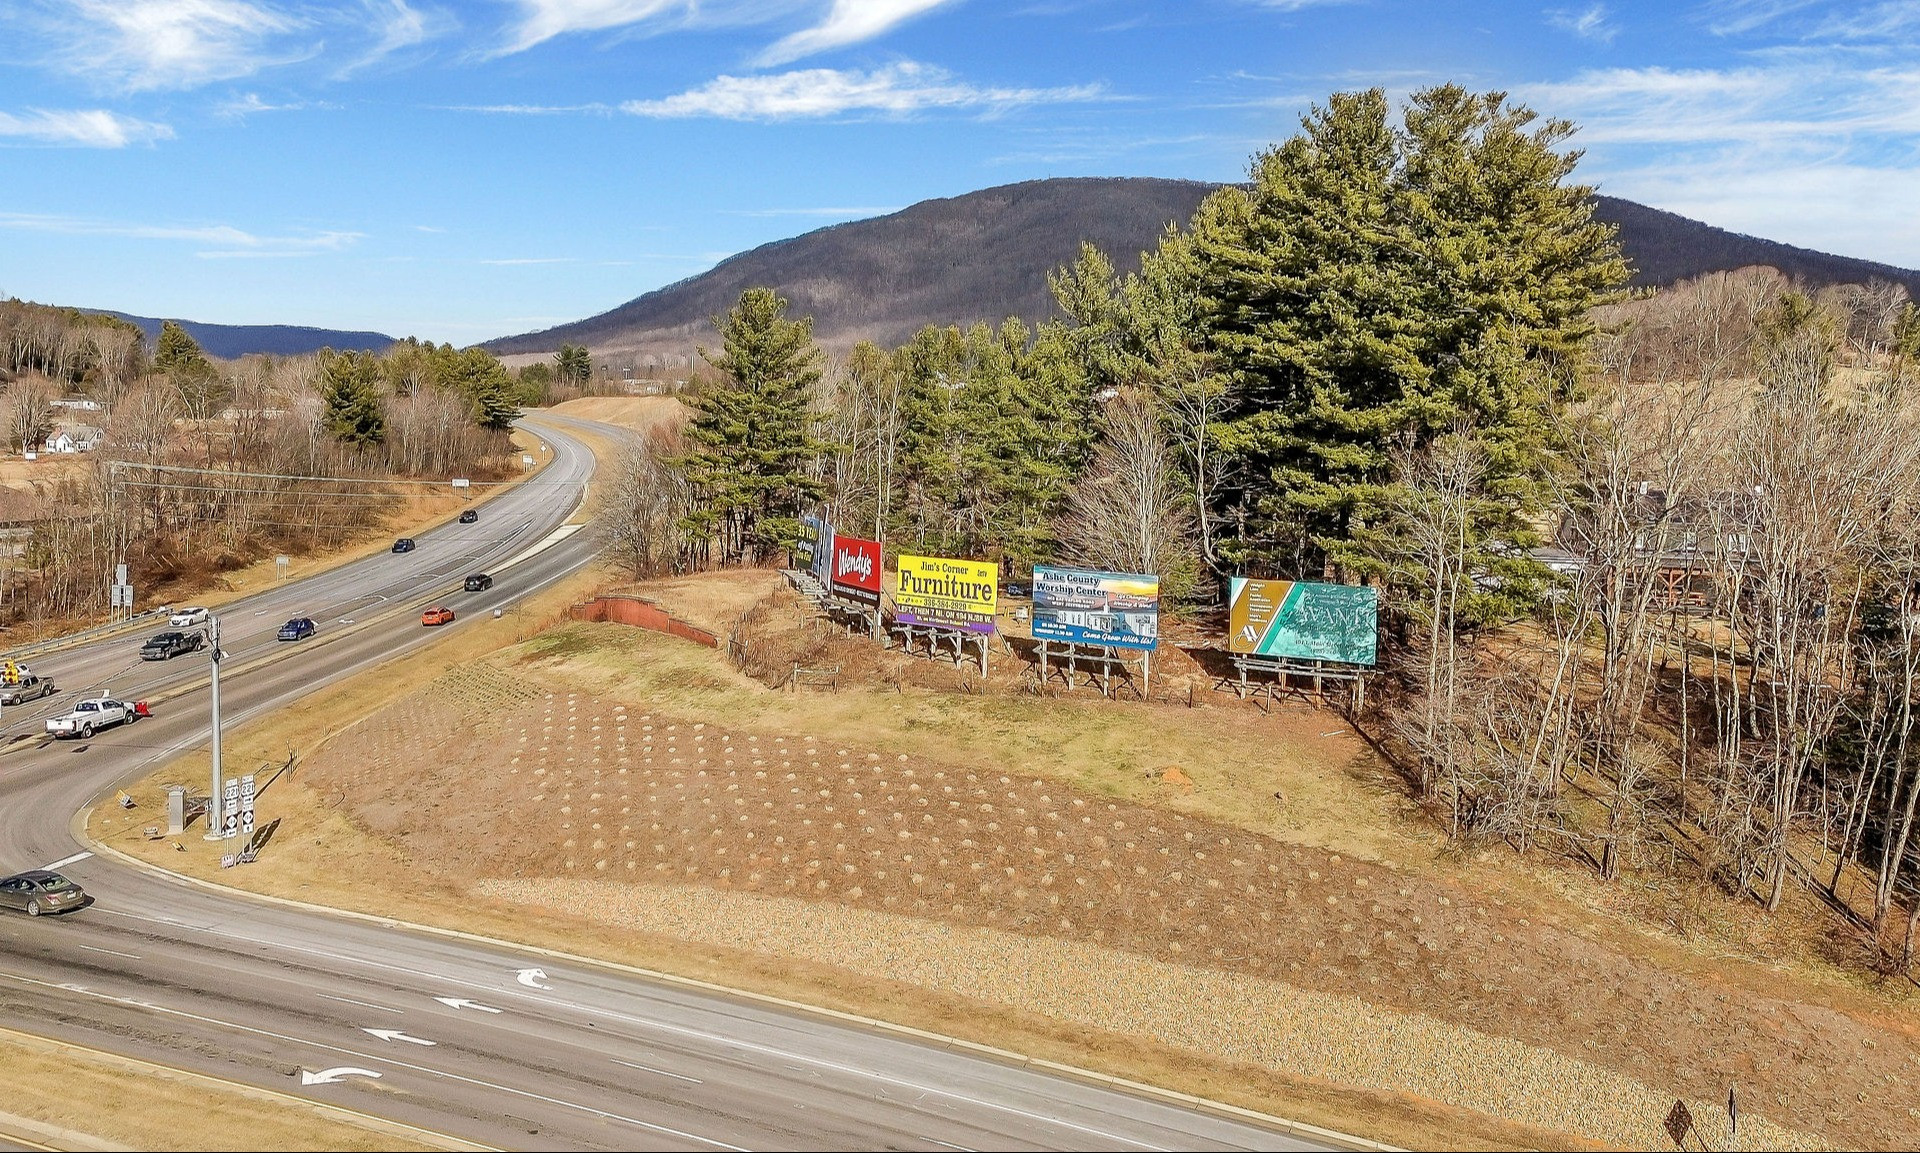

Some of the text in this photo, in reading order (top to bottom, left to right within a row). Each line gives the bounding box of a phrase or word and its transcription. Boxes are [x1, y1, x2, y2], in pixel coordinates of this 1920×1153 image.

[838, 546, 872, 582] Wendy's
[920, 562, 968, 575] Jim's Corner
[900, 570, 992, 602] Furniture
[1043, 572, 1100, 587] Ashe County
[1036, 582, 1106, 597] Worship Center
[914, 606, 930, 616] THEN
[1082, 631, 1154, 645] Come Grow With Us!
[226, 784, 254, 797] 221 221
